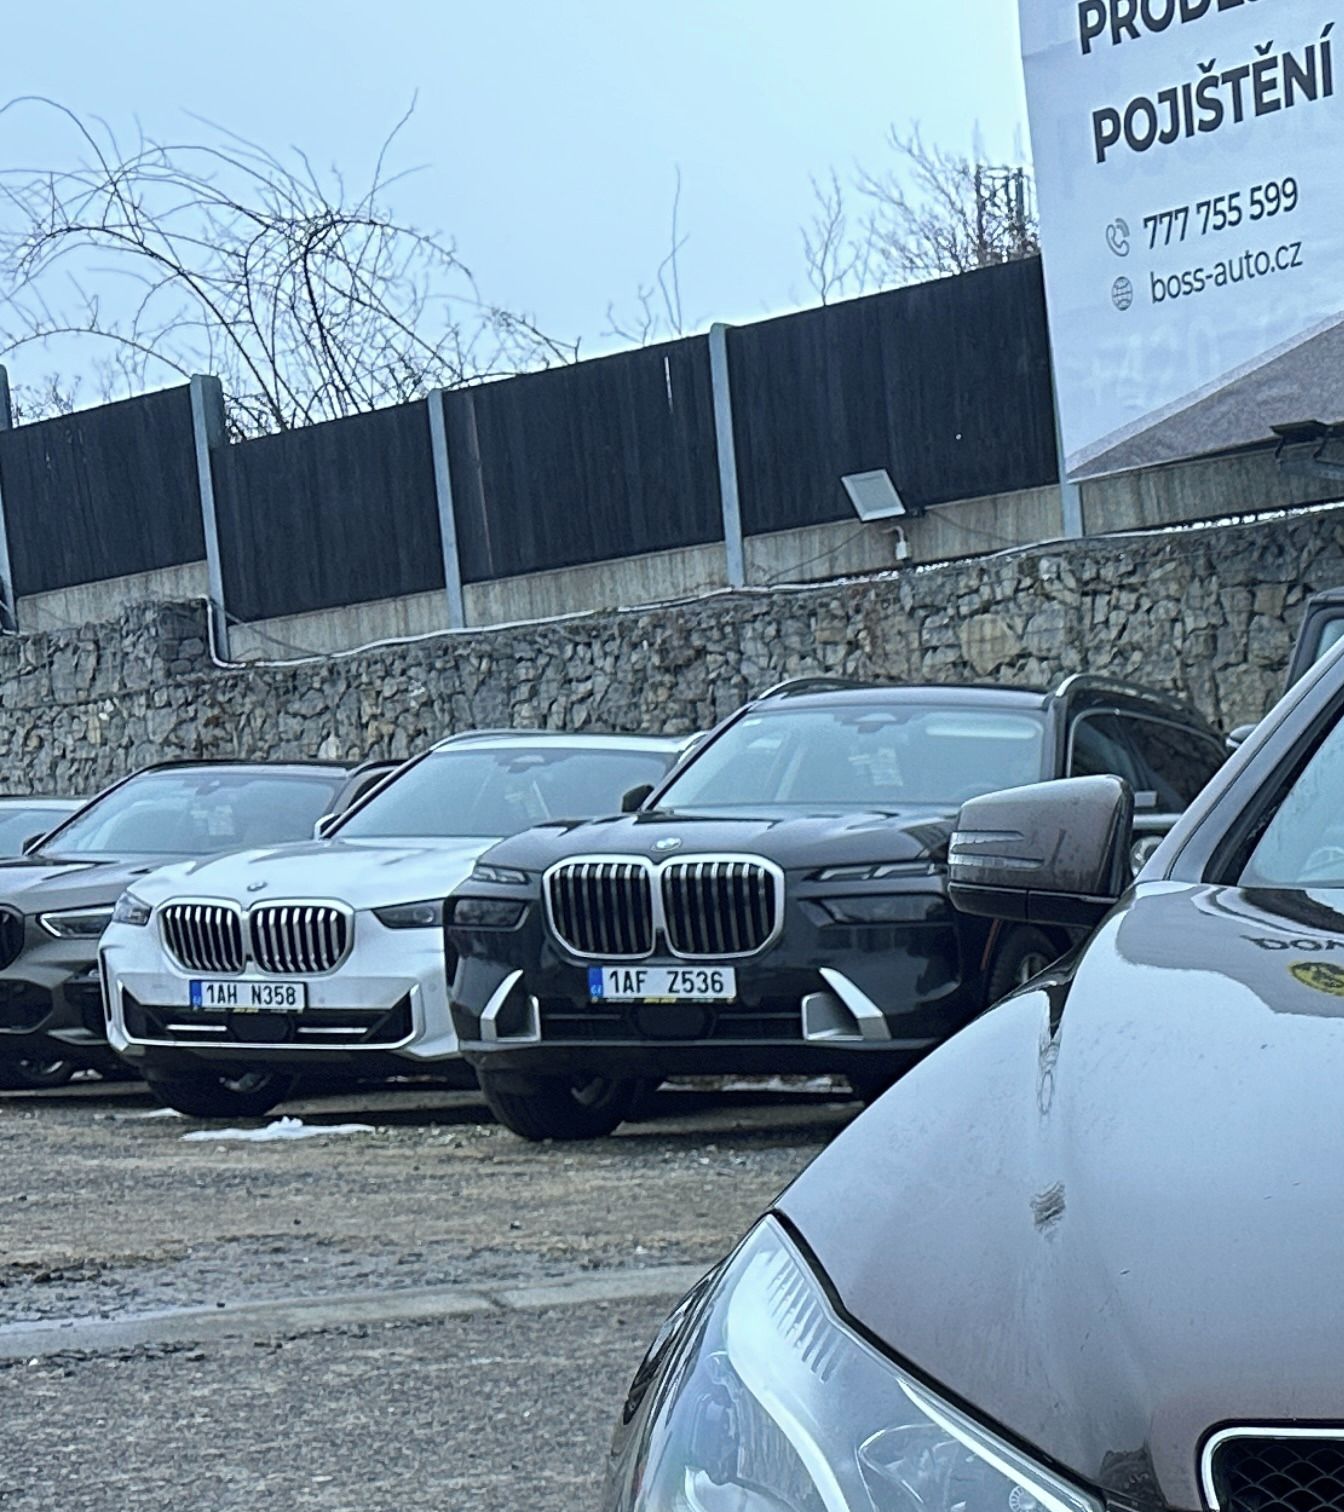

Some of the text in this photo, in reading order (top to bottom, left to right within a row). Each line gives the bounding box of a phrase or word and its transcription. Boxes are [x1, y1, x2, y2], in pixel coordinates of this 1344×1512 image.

[1078, 0, 1259, 55] PRO
[1092, 22, 1335, 164] POJIŠTĚNÍ
[1143, 177, 1298, 250] 777 755 599
[1150, 241, 1303, 303] boss-auto.cz
[206, 984, 238, 1004] 1AH
[251, 985, 296, 1006] N358
[609, 970, 724, 994] 1AF Z536
